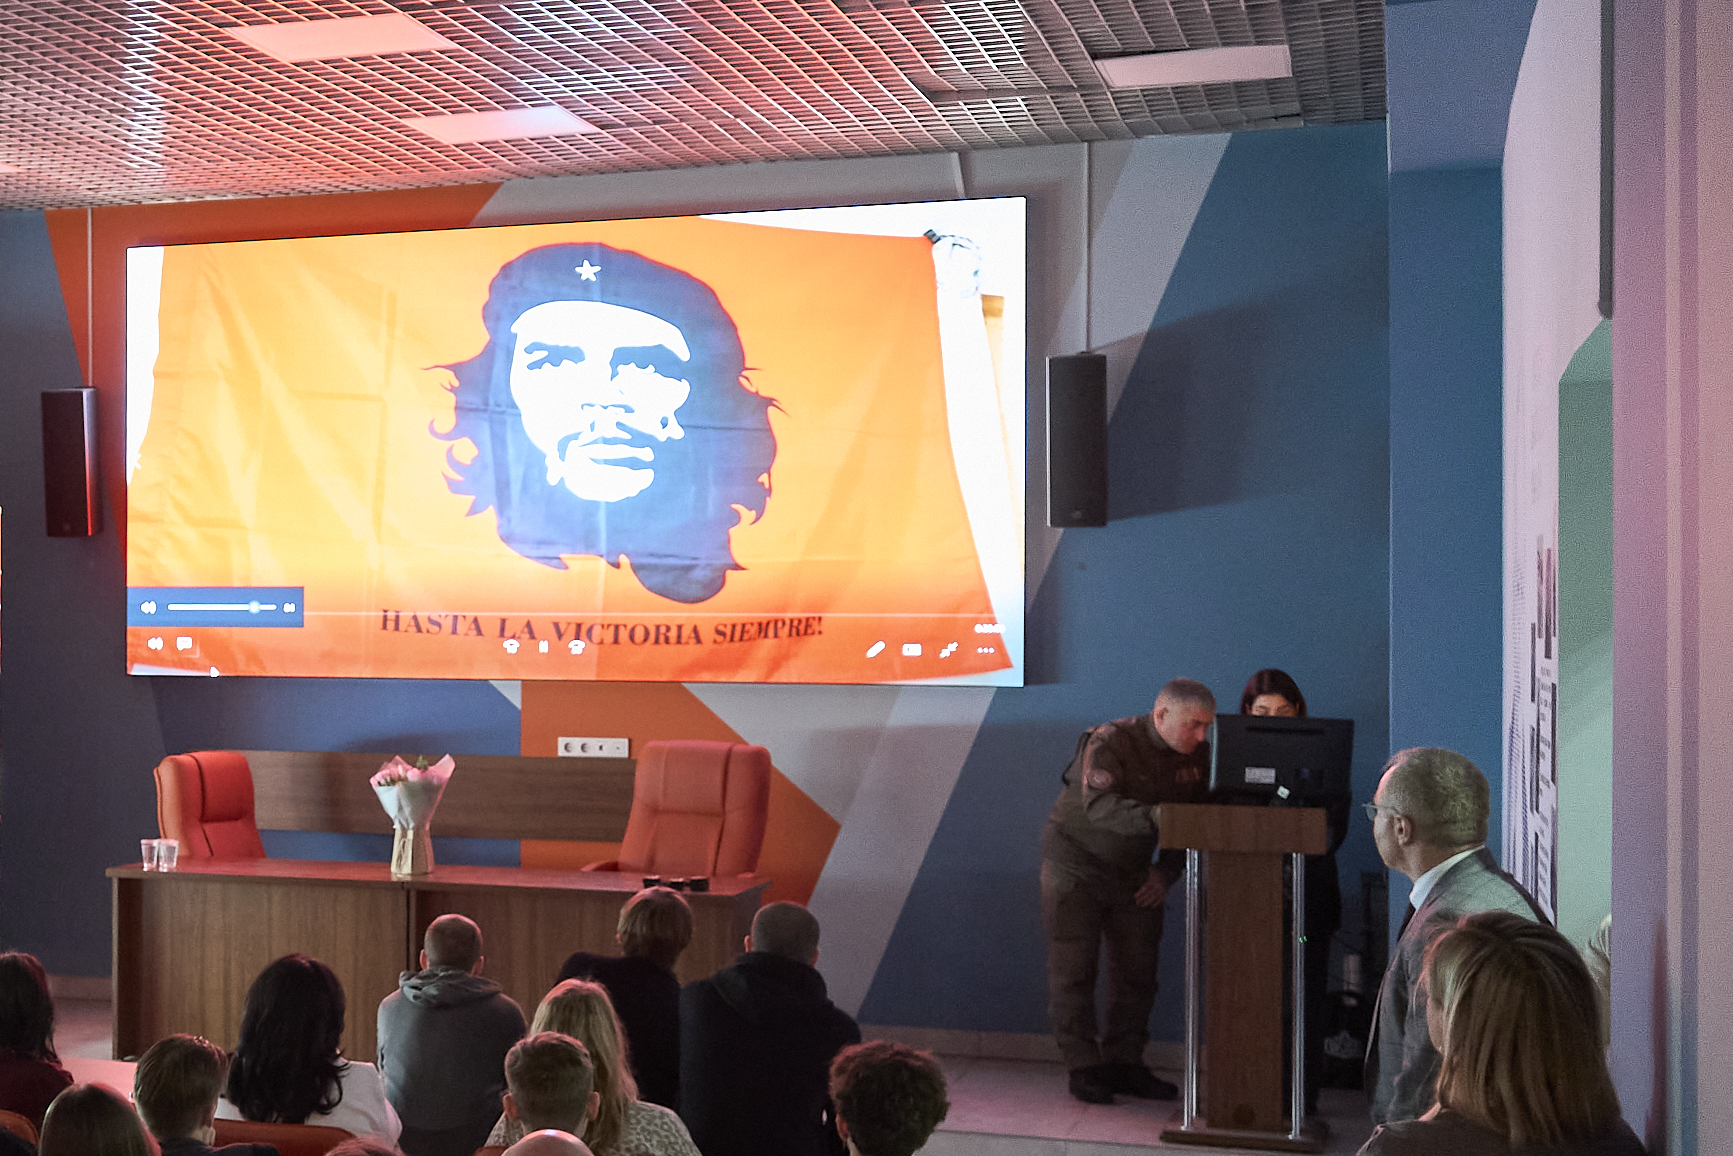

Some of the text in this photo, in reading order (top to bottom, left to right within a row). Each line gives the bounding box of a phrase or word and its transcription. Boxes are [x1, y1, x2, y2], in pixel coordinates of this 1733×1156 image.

[380, 609, 823, 645] HASTA LA VICTORIA SIEMPRE!
